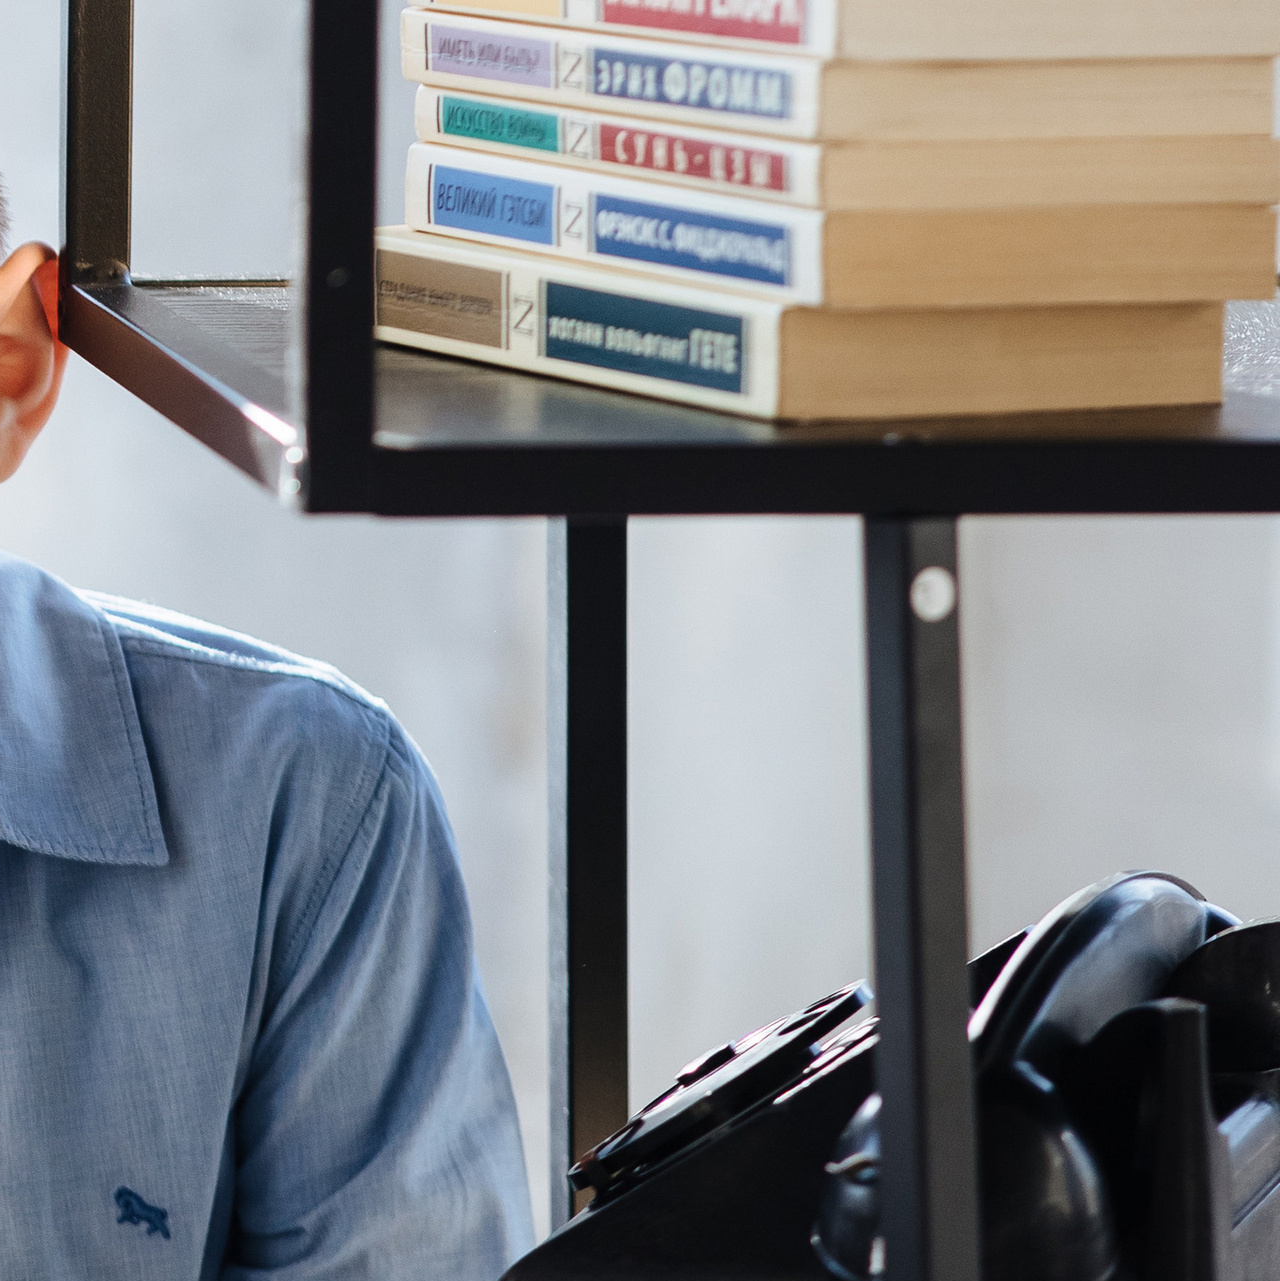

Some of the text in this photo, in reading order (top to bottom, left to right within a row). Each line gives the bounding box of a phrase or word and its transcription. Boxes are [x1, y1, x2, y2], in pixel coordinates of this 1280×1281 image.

[596, 58, 784, 115] ЭРИХ ФРОММ
[447, 105, 505, 137] ИСКУССТВО
[614, 129, 771, 187] СУНЬ-ЦЗЫ
[437, 183, 546, 226] ВЕЛИКИЙ ГЭТСБИ
[689, 328, 737, 375] ГЕТЕ
